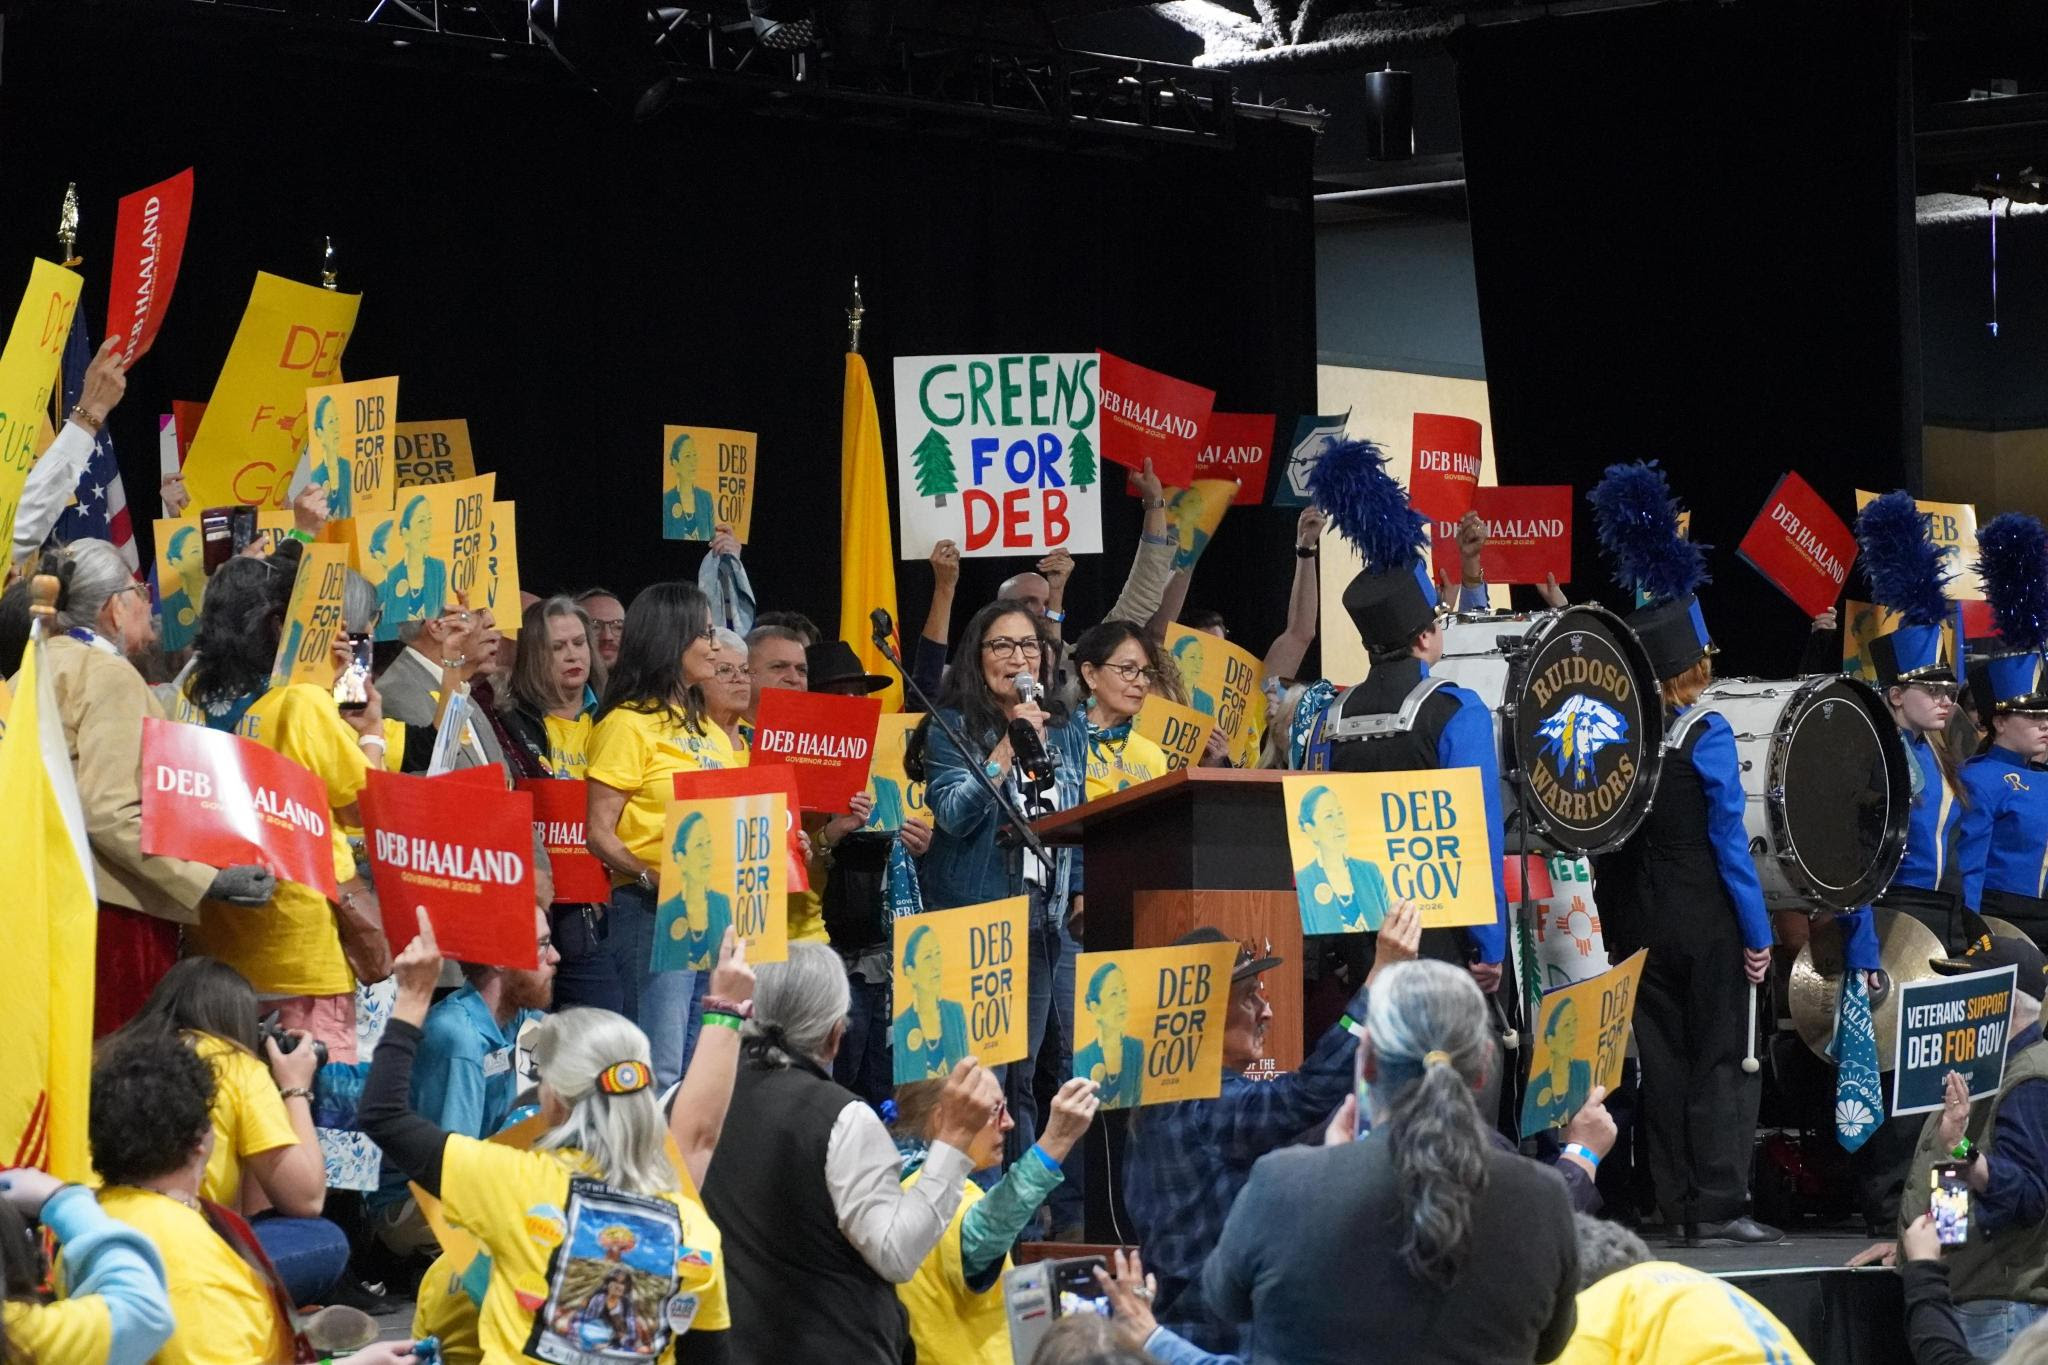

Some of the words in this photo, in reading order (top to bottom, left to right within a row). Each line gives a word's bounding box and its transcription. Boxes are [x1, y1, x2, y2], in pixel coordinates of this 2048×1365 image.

[135, 196, 161, 317] HAALAND
[918, 355, 1097, 431] GREENS
[355, 395, 385, 435] DEB
[1122, 397, 1198, 440] HAALAND
[355, 434, 385, 460] FOR
[395, 432, 451, 460] DEB
[717, 443, 748, 475] DEB
[971, 432, 1066, 489] FOR
[1197, 444, 1263, 464] ALAND
[1420, 450, 1451, 471] DEB
[353, 456, 384, 494] GOV
[397, 460, 454, 477] FOR
[718, 476, 746, 497] FOR
[455, 493, 483, 534] DEB
[717, 494, 745, 524] GOV
[962, 488, 1071, 552] DEB
[1927, 512, 1960, 541] EB
[453, 532, 481, 559] FOR
[1771, 502, 1801, 535] DEB
[1796, 526, 1845, 584] HAALAND
[450, 554, 481, 594] GOV
[311, 605, 341, 628] FOR
[300, 627, 336, 664] GOV
[1224, 655, 1254, 697] DEB
[1532, 656, 1631, 709] RUIDOSO
[1221, 687, 1247, 716] FOR
[1161, 716, 1201, 754] DEB
[1217, 703, 1243, 740] GOV
[760, 728, 796, 753] DEB
[796, 731, 868, 759] HAALAND
[785, 755, 822, 765] GOVERNOR
[823, 759, 842, 767] 2026
[156, 765, 212, 798] DEB
[242, 780, 325, 837] ALAND
[1530, 752, 1636, 821] WARRIORS
[2003, 772, 2030, 792] R
[1381, 790, 1457, 833] DEB
[548, 821, 587, 845] HAAL
[736, 815, 771, 864] DEB
[1386, 835, 1461, 862] FOR
[374, 828, 408, 868] DEB
[411, 838, 524, 885] HAALAND
[736, 866, 770, 894] FOR
[1391, 860, 1462, 901] GOV
[735, 893, 770, 939] GOV
[1419, 902, 1444, 911] 2026
[969, 920, 1013, 970] DEB
[971, 967, 1013, 1001] FOR
[1157, 963, 1212, 1010] DEB
[1601, 976, 1630, 1029] DEB
[971, 994, 1013, 1042] GOV
[1153, 1009, 1207, 1039] FOR
[1907, 999, 1966, 1030] VETERANS
[1967, 991, 2010, 1020] SUPPORT
[1597, 1016, 1626, 1056] FOR
[1907, 1032, 1943, 1070] DEB
[1944, 1027, 1977, 1065] FOR
[1976, 1020, 2006, 1058] GOV
[1147, 1034, 1204, 1078] GOV
[1259, 1058, 1276, 1070] THE
